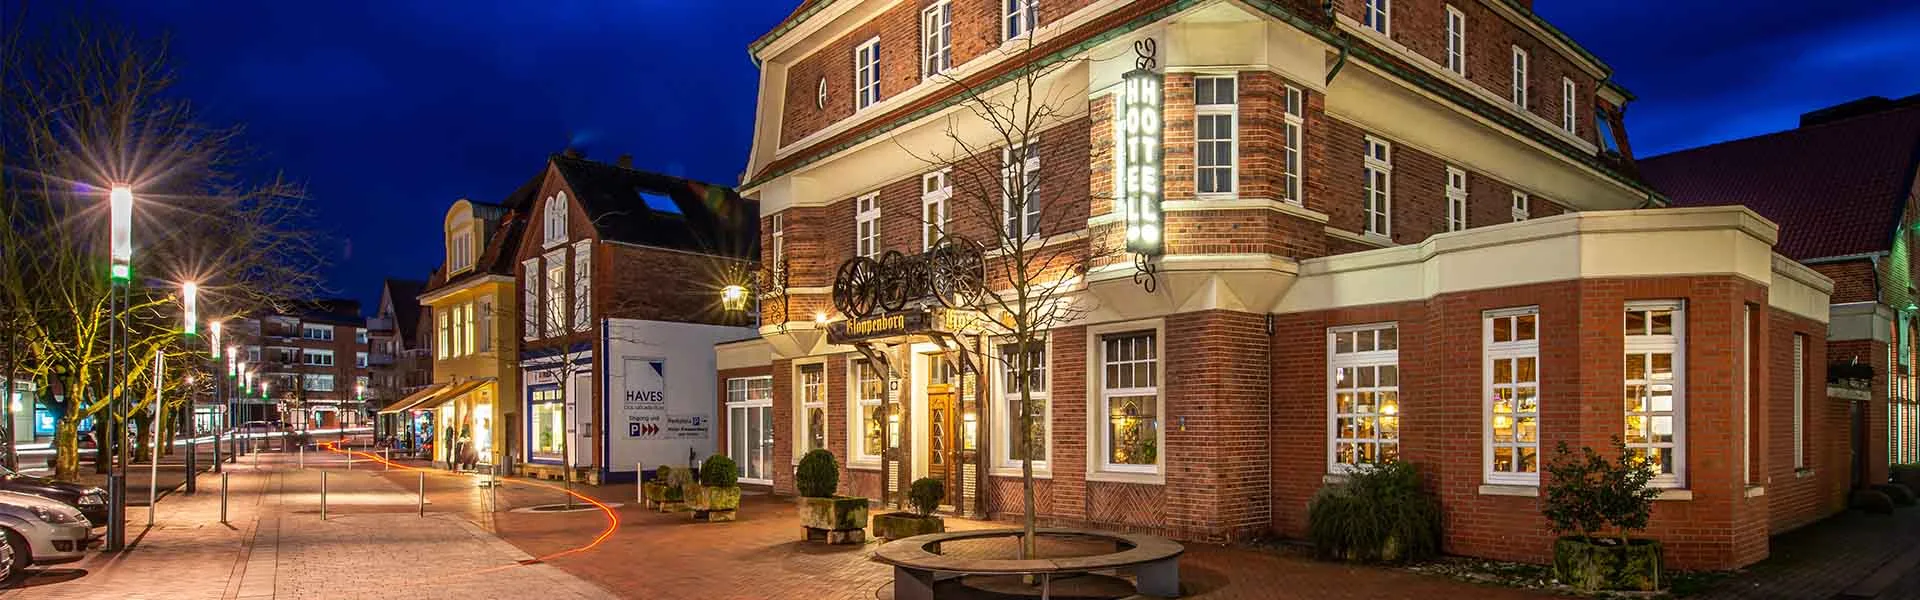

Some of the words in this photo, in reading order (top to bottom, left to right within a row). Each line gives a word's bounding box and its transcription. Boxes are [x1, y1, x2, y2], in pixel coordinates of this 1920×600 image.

[1127, 77, 1140, 222] HOTEL
[1141, 78, 1158, 222] HOTEL
[626, 391, 663, 401] HAVES
